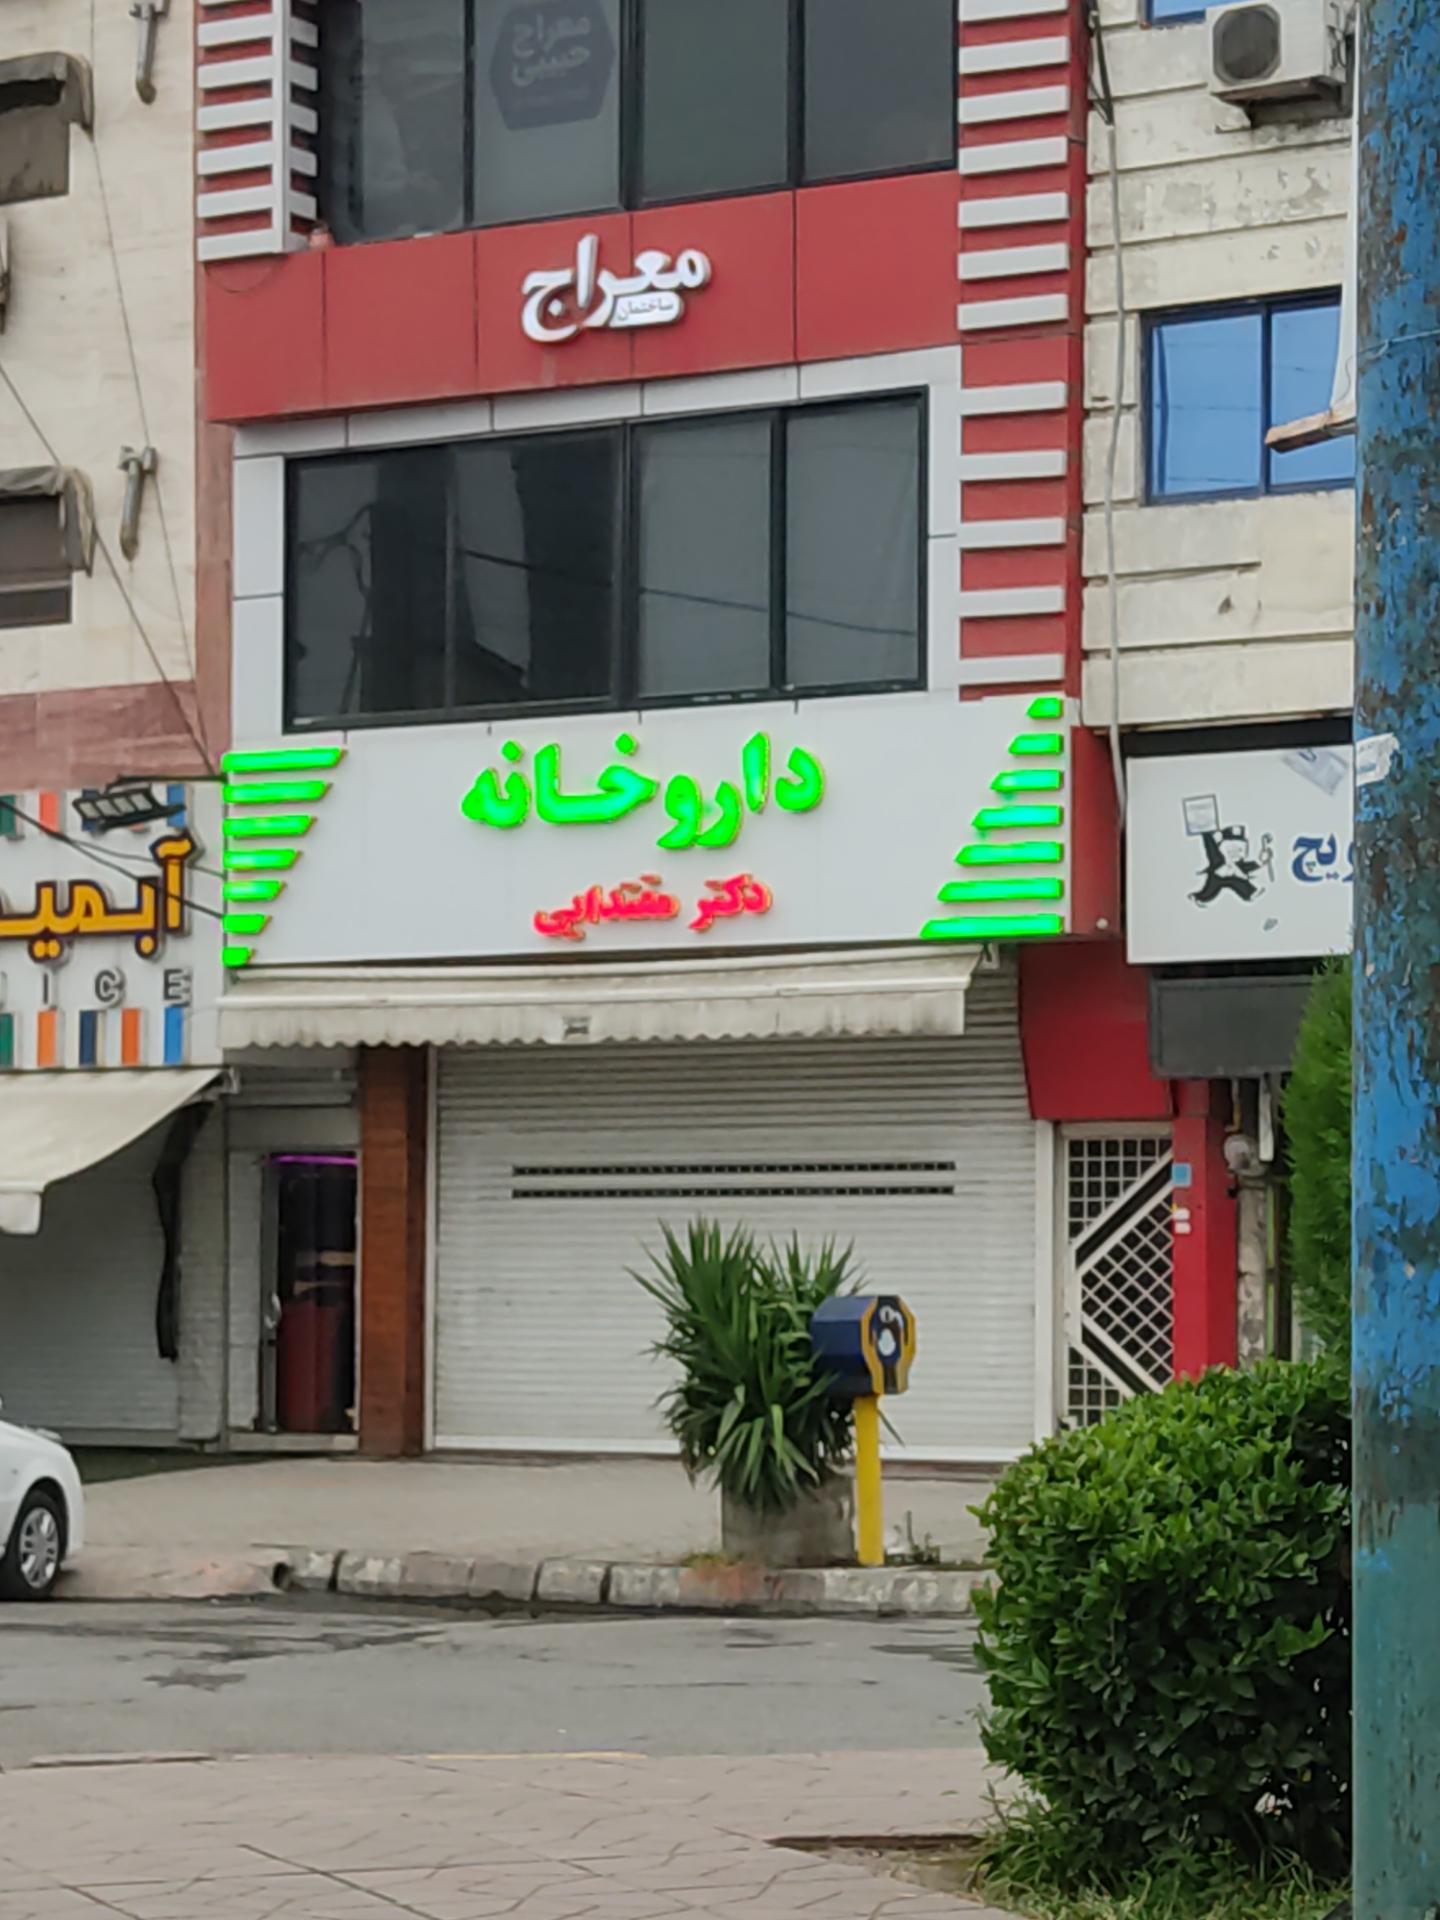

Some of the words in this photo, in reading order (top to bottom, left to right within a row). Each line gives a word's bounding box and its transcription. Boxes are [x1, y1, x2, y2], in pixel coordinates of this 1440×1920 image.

[512, 13, 592, 58] معراج
[521, 233, 712, 344] معراج
[616, 297, 675, 321] ساختمان
[461, 731, 825, 849] داروخانه
[0, 830, 197, 962] آبمی
[688, 873, 774, 932] دکتر
